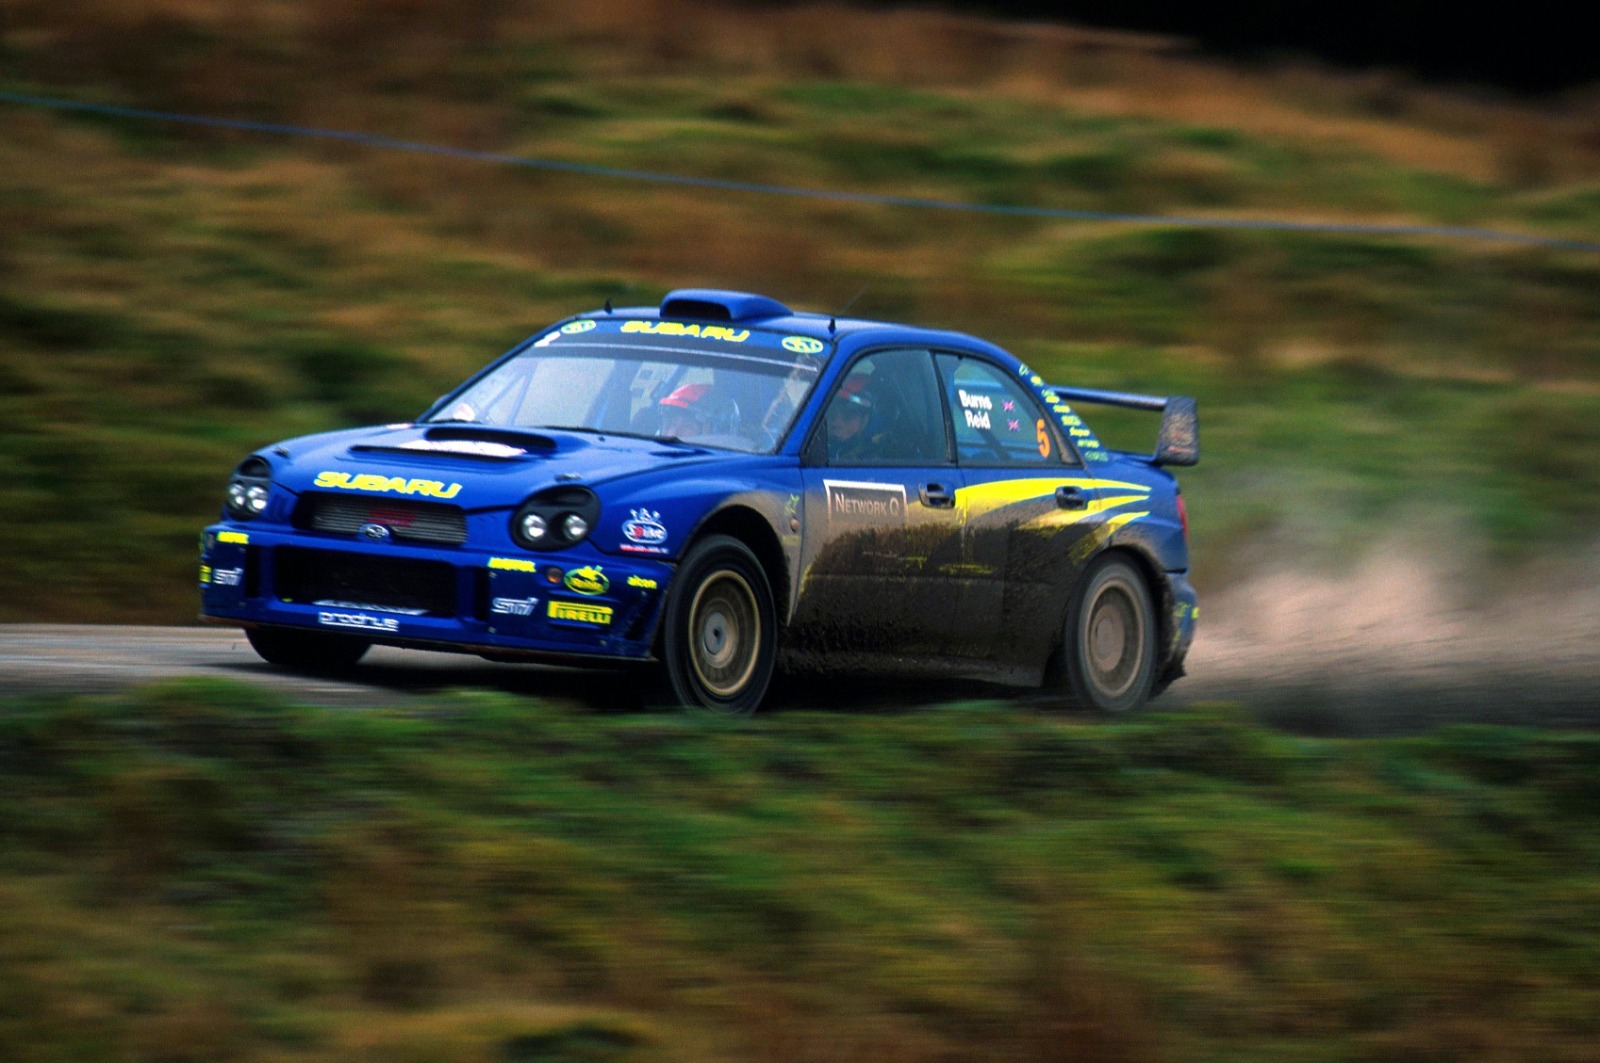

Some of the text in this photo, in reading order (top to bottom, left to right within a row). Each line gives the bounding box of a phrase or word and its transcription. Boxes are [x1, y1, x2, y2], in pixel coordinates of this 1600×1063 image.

[620, 320, 751, 342] SUBARU
[959, 389, 993, 410] Burns
[964, 409, 991, 430] Reid
[1036, 418, 1051, 458] 5
[314, 471, 463, 499] SUBARU
[889, 496, 900, 518] Q
[547, 600, 614, 625] PIRELLI
